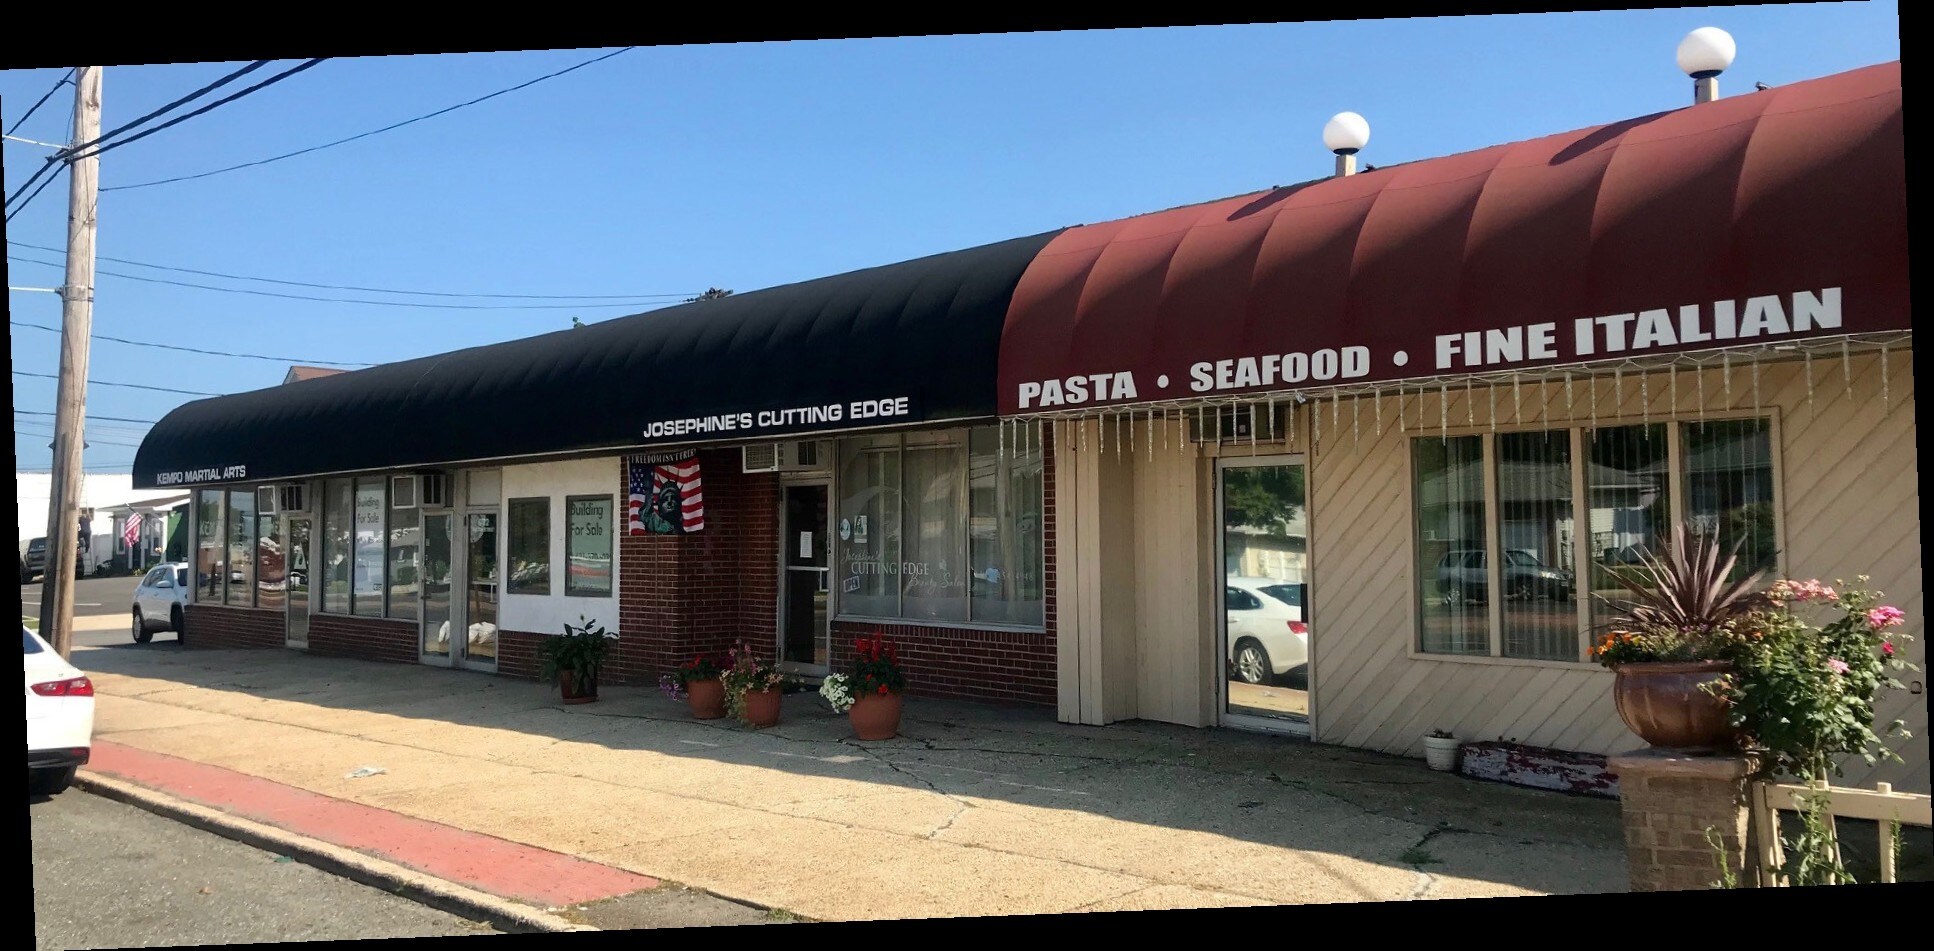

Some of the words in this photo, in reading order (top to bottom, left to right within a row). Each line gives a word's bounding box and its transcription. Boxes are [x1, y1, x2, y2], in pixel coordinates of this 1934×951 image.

[1018, 371, 1138, 409] PASTA
[1190, 345, 1370, 392] SEAFOOD
[1435, 322, 1558, 369] FINE
[1575, 287, 1842, 355] ITALIAN
[643, 412, 753, 438] JOSEPHINE'S
[758, 404, 843, 427] CUTTING
[850, 396, 909, 419] EDGE
[631, 454, 662, 464] FREEDOM
[157, 472, 183, 485] KEMPO
[185, 468, 221, 482] MARTIAL
[223, 465, 246, 479] ARTS
[571, 502, 603, 519] Building
[570, 522, 584, 536] For
[586, 522, 603, 536] Sale
[851, 561, 897, 575] CUTTING
[903, 562, 929, 575] EDGE
